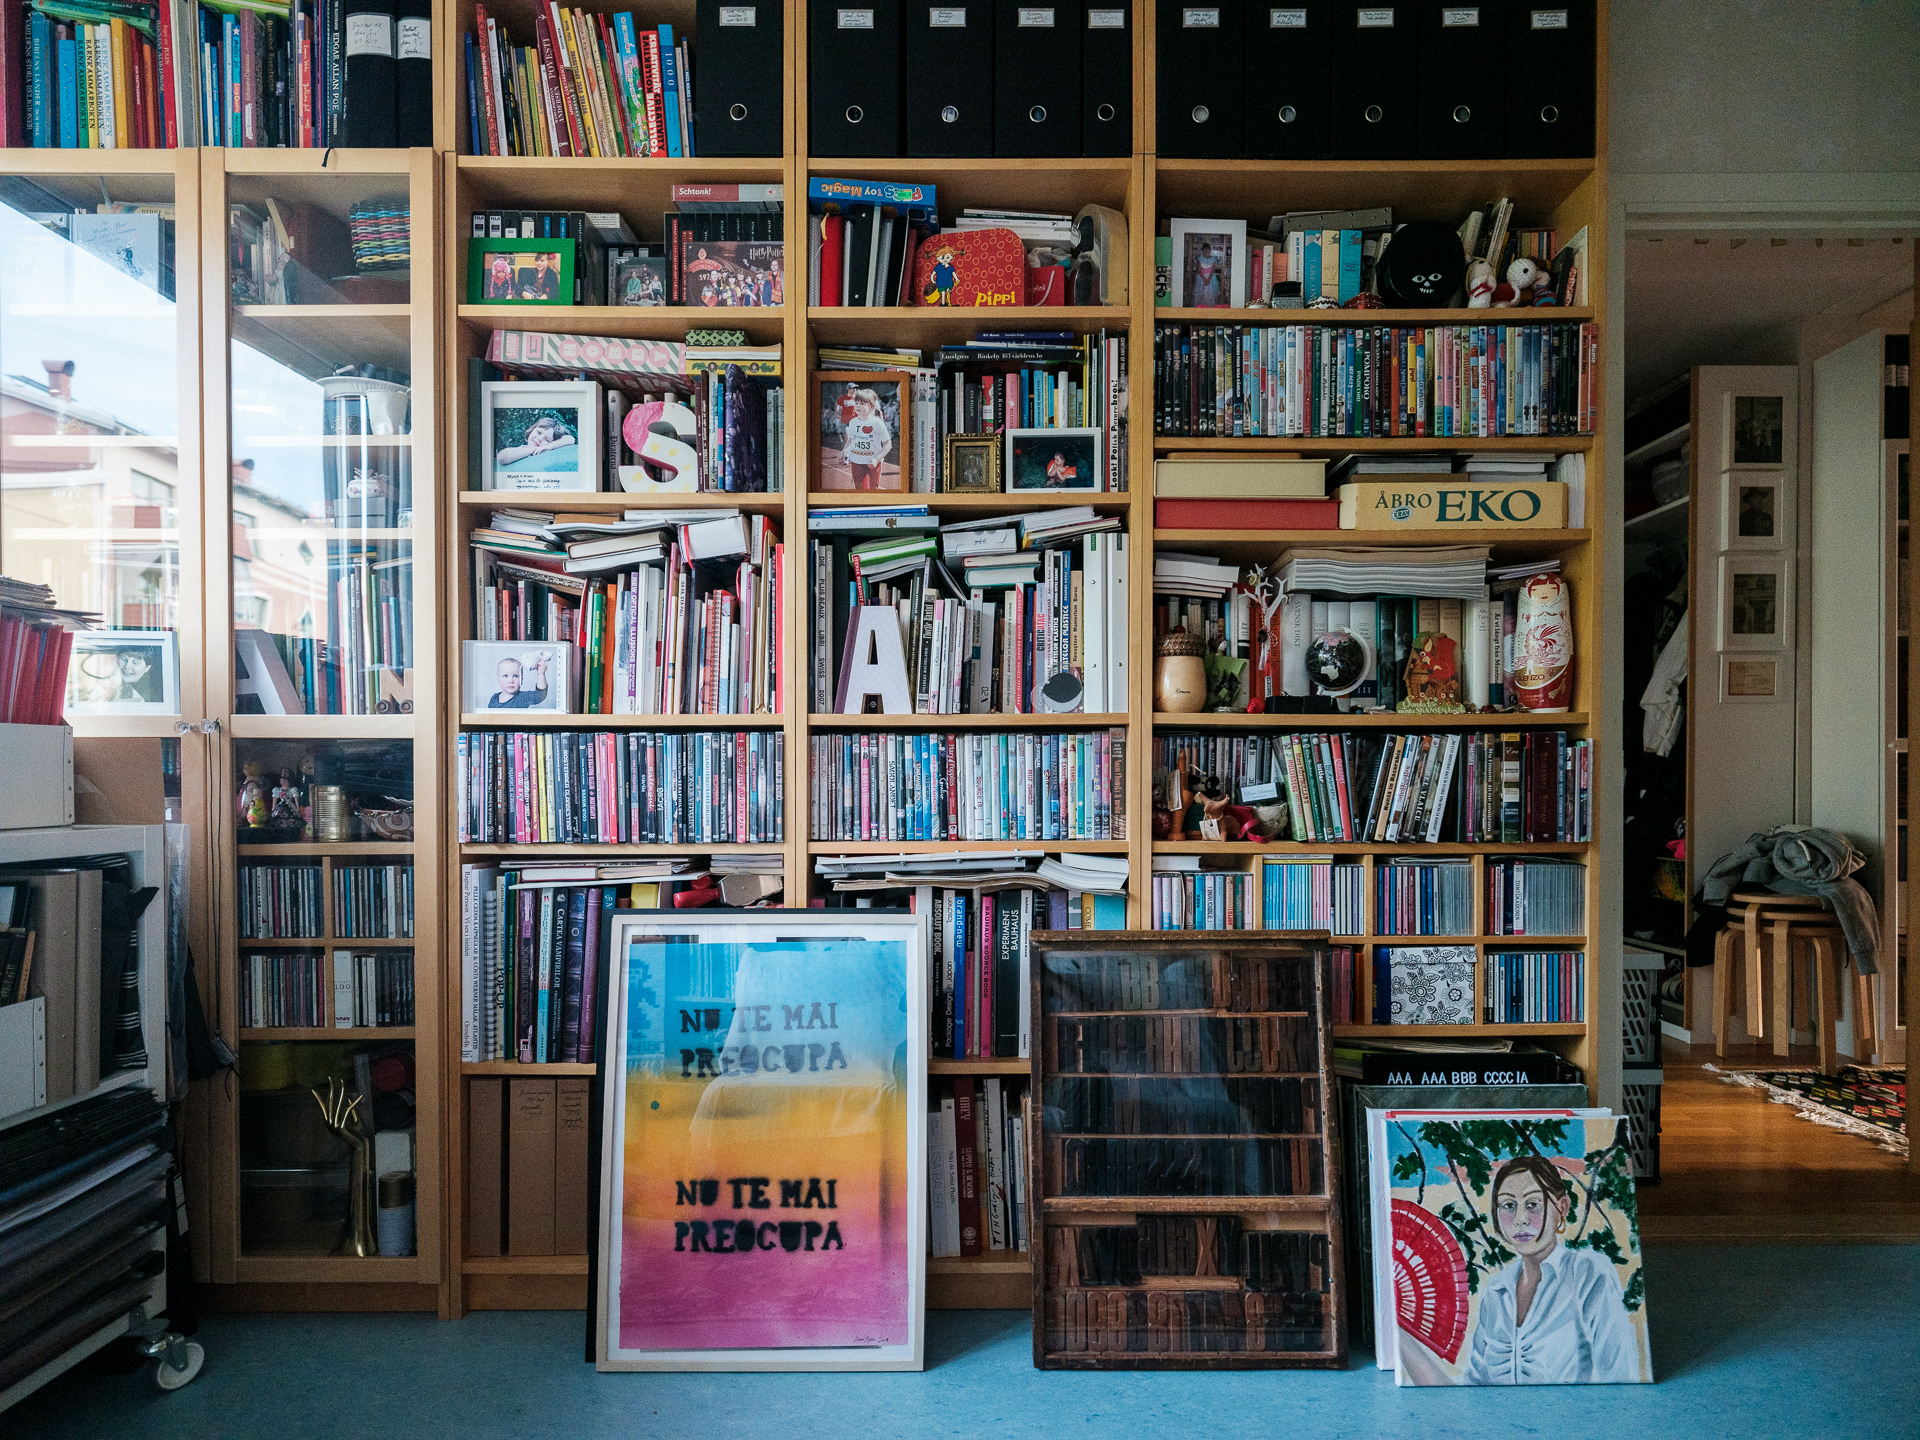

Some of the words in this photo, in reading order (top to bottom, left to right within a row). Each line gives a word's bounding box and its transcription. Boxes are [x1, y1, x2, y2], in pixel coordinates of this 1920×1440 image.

[642, 36, 652, 93] KOLLEKTIVE
[650, 34, 660, 94] KREATIVITÄT
[77, 40, 86, 129] BARNKAMMARBOKEN
[86, 40, 95, 129] BARNKAMMARBOKEN
[95, 39, 104, 129] BARNKAMMARBOKEN
[101, 38, 112, 136] BARNKAMMARBOKEN
[647, 93, 658, 153] COLLECTIVE
[654, 94, 664, 151] CREATIVITY
[821, 182, 862, 197] Magic
[864, 187, 883, 196] Toy
[563, 343, 668, 364] HOBBY
[609, 435, 618, 470] Piraterna
[619, 401, 697, 492] S
[1375, 490, 1432, 508] ÅBRO
[1436, 490, 1541, 522] EKO
[1037, 613, 1045, 651] CRITICATAC
[835, 606, 913, 714] A
[1391, 750, 1402, 782] Basarabia
[1415, 791, 1427, 821] VLAICU
[556, 909, 564, 939] CARTEA
[934, 899, 942, 930] ABSOLUT
[933, 932, 941, 955] BOOK.
[554, 941, 563, 988] VAMPIRILOR
[496, 968, 504, 1009] POP-UP
[680, 1008, 721, 1033] NU
[734, 1005, 772, 1032] TE
[680, 1042, 848, 1077] PREOCUPA
[1387, 1072, 1412, 1084] AAA
[1421, 1072, 1447, 1084] AAA
[1451, 1072, 1477, 1084] BBB
[1484, 1071, 1514, 1084] CCCC
[931, 1145, 940, 1169] LISA
[676, 1179, 719, 1206] NU
[728, 1178, 770, 1209] TE
[780, 1178, 837, 1209] MAI
[932, 1172, 942, 1209] BAUER
[674, 1220, 846, 1253] PREOCUPA
